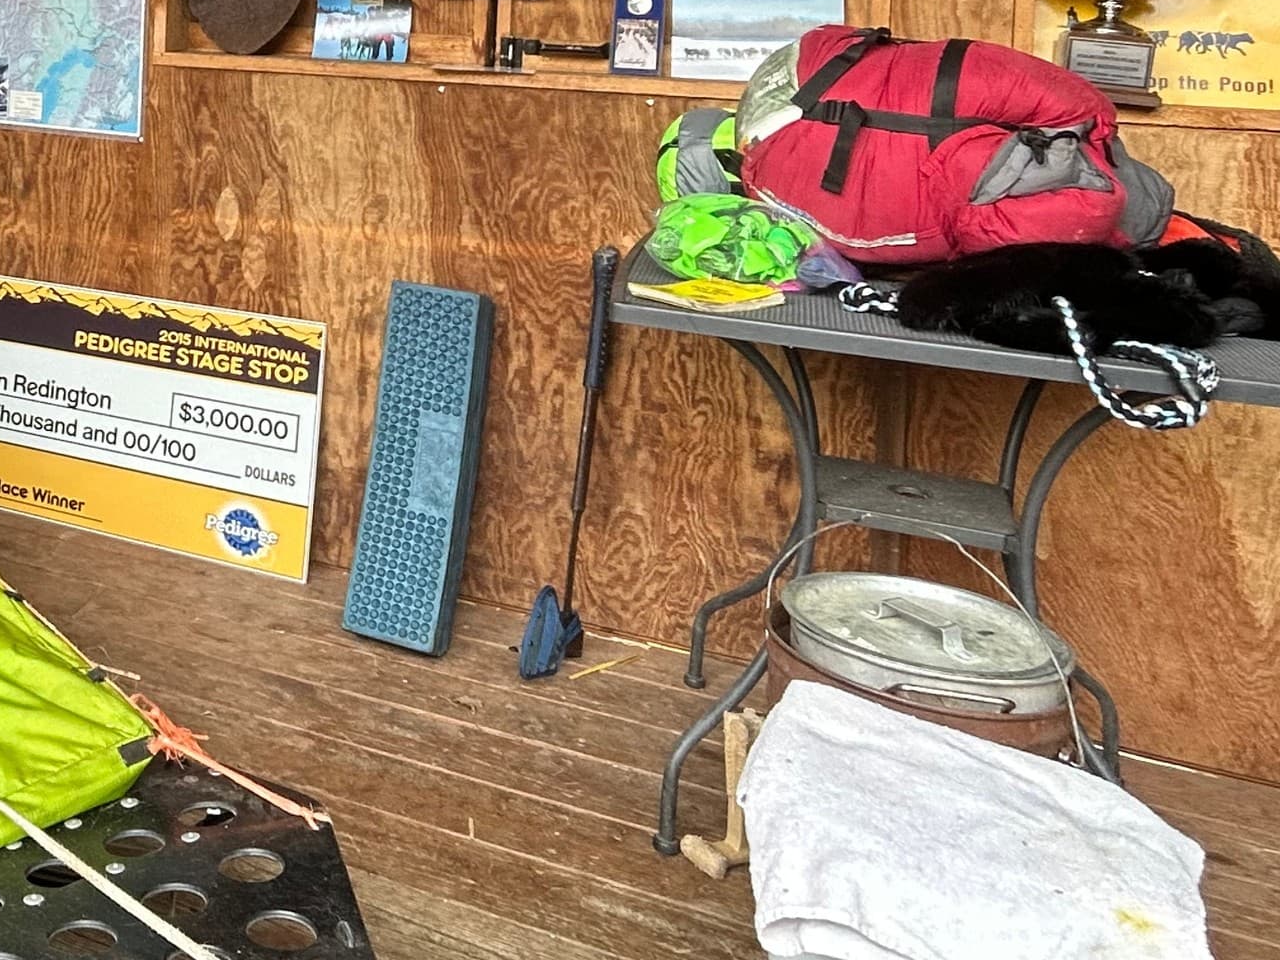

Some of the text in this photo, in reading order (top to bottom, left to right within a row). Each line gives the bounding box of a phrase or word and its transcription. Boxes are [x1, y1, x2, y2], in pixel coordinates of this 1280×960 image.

[1178, 76, 1209, 90] the
[1220, 77, 1275, 96] Poop!
[74, 330, 309, 386] PEDIGREE STAGE STOP
[158, 329, 310, 366] 2015 INTERNATIONAL
[13, 374, 112, 410] Redington
[178, 401, 289, 440] $3,000.00
[82, 425, 118, 445] and
[122, 431, 197, 462] 00/100
[244, 465, 297, 487] DOLLARS
[31, 486, 86, 512] Winner
[204, 514, 279, 546] Pedigree
